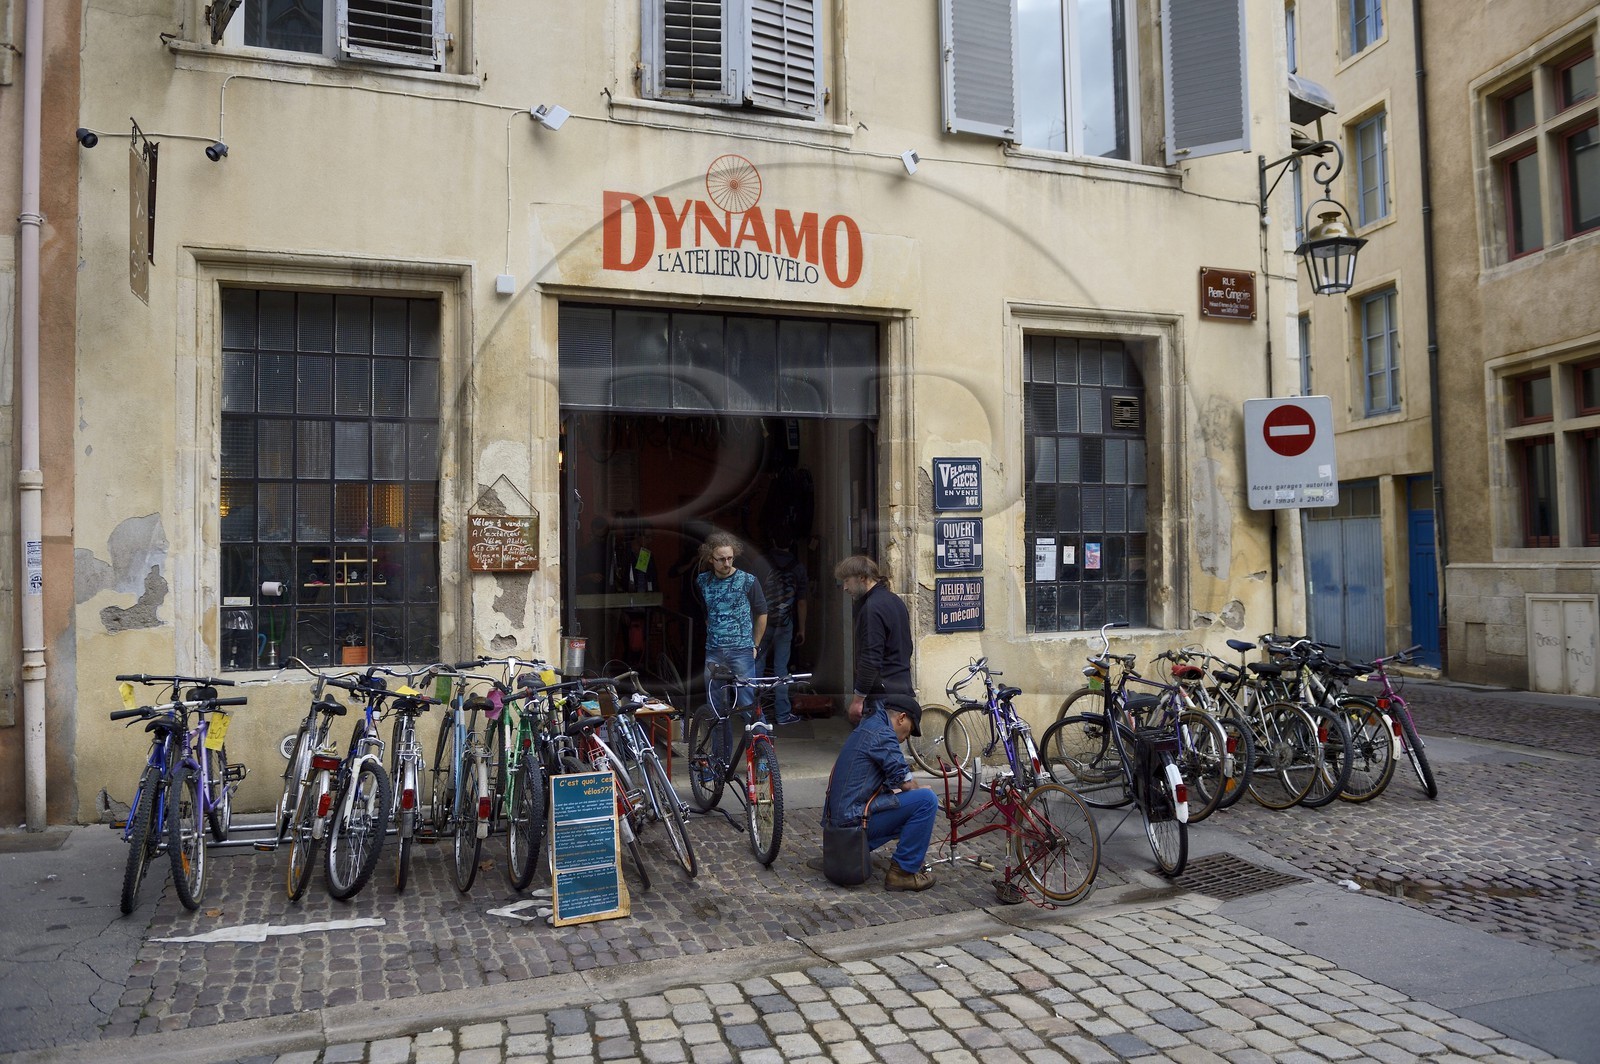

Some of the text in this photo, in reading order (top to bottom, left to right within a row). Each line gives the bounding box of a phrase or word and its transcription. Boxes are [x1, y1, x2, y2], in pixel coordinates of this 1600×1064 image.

[603, 190, 862, 288] DYNAMO
[658, 249, 819, 284] L'ATELIER DU VELO
[1222, 277, 1236, 286] RUE
[1208, 286, 1224, 298] Pierre
[953, 472, 978, 486] PIECES
[966, 496, 978, 505] ICI
[472, 518, 494, 526] Vélos
[944, 522, 975, 538] OUVERT
[940, 583, 980, 595] ATELIER VELO
[941, 607, 979, 624] le mécano
[582, 777, 598, 786] quoi,
[584, 786, 613, 795] vélos???
